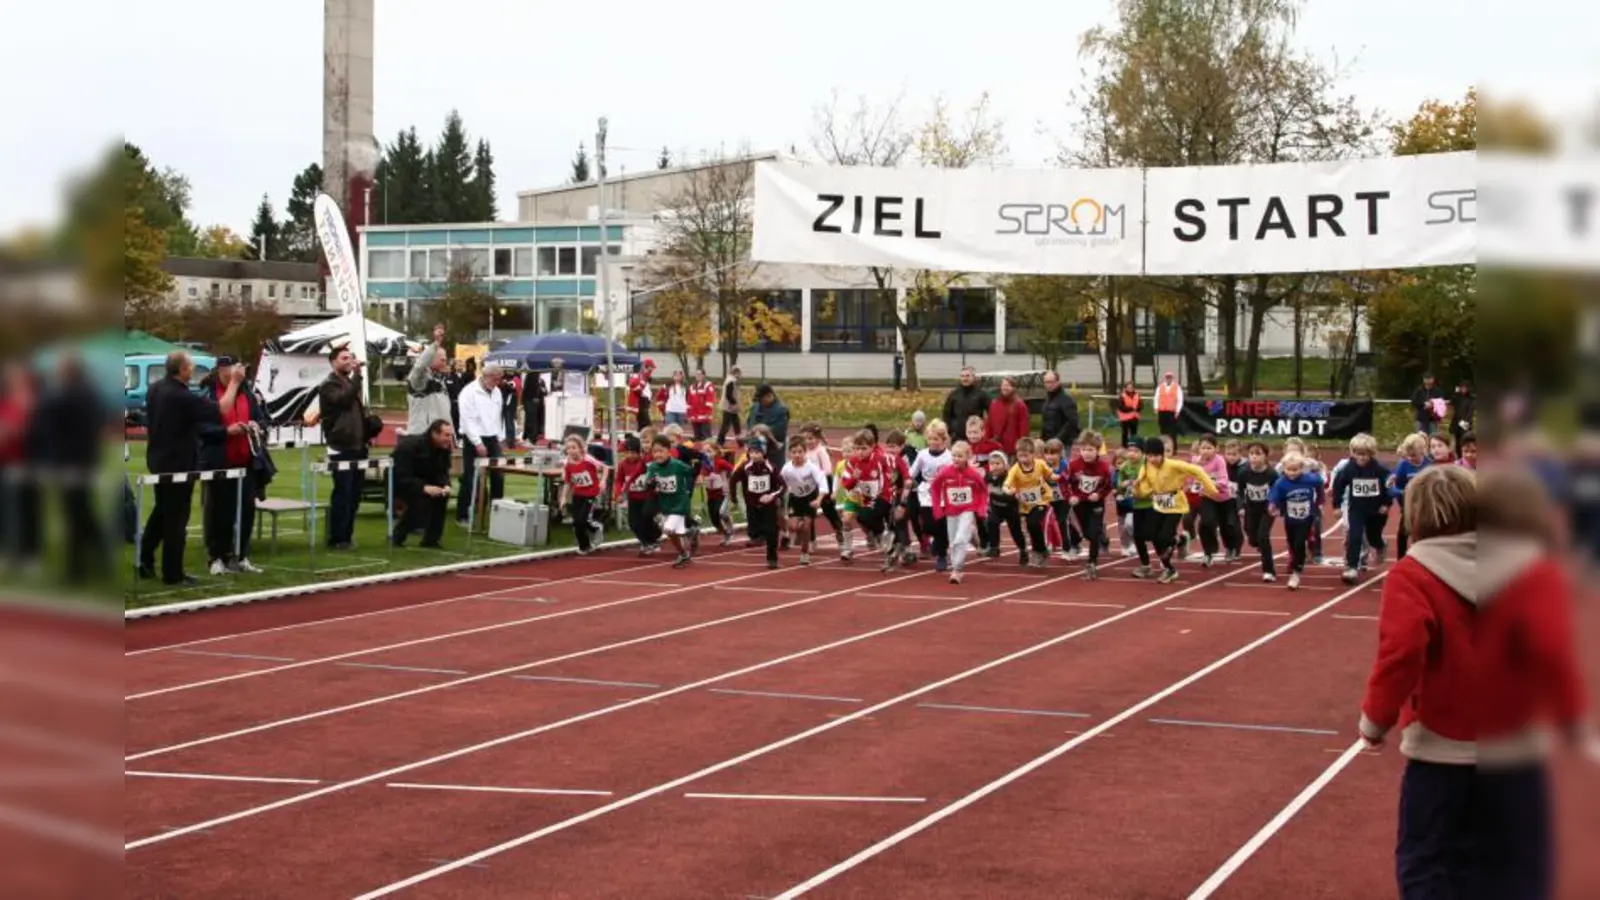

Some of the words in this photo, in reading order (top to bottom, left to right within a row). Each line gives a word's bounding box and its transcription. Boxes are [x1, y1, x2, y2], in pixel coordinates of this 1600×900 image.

[813, 194, 941, 239] ZIEL
[1173, 191, 1390, 242] START
[753, 480, 766, 491] 39
[1354, 483, 1377, 494] 904
[951, 492, 966, 502] 29
